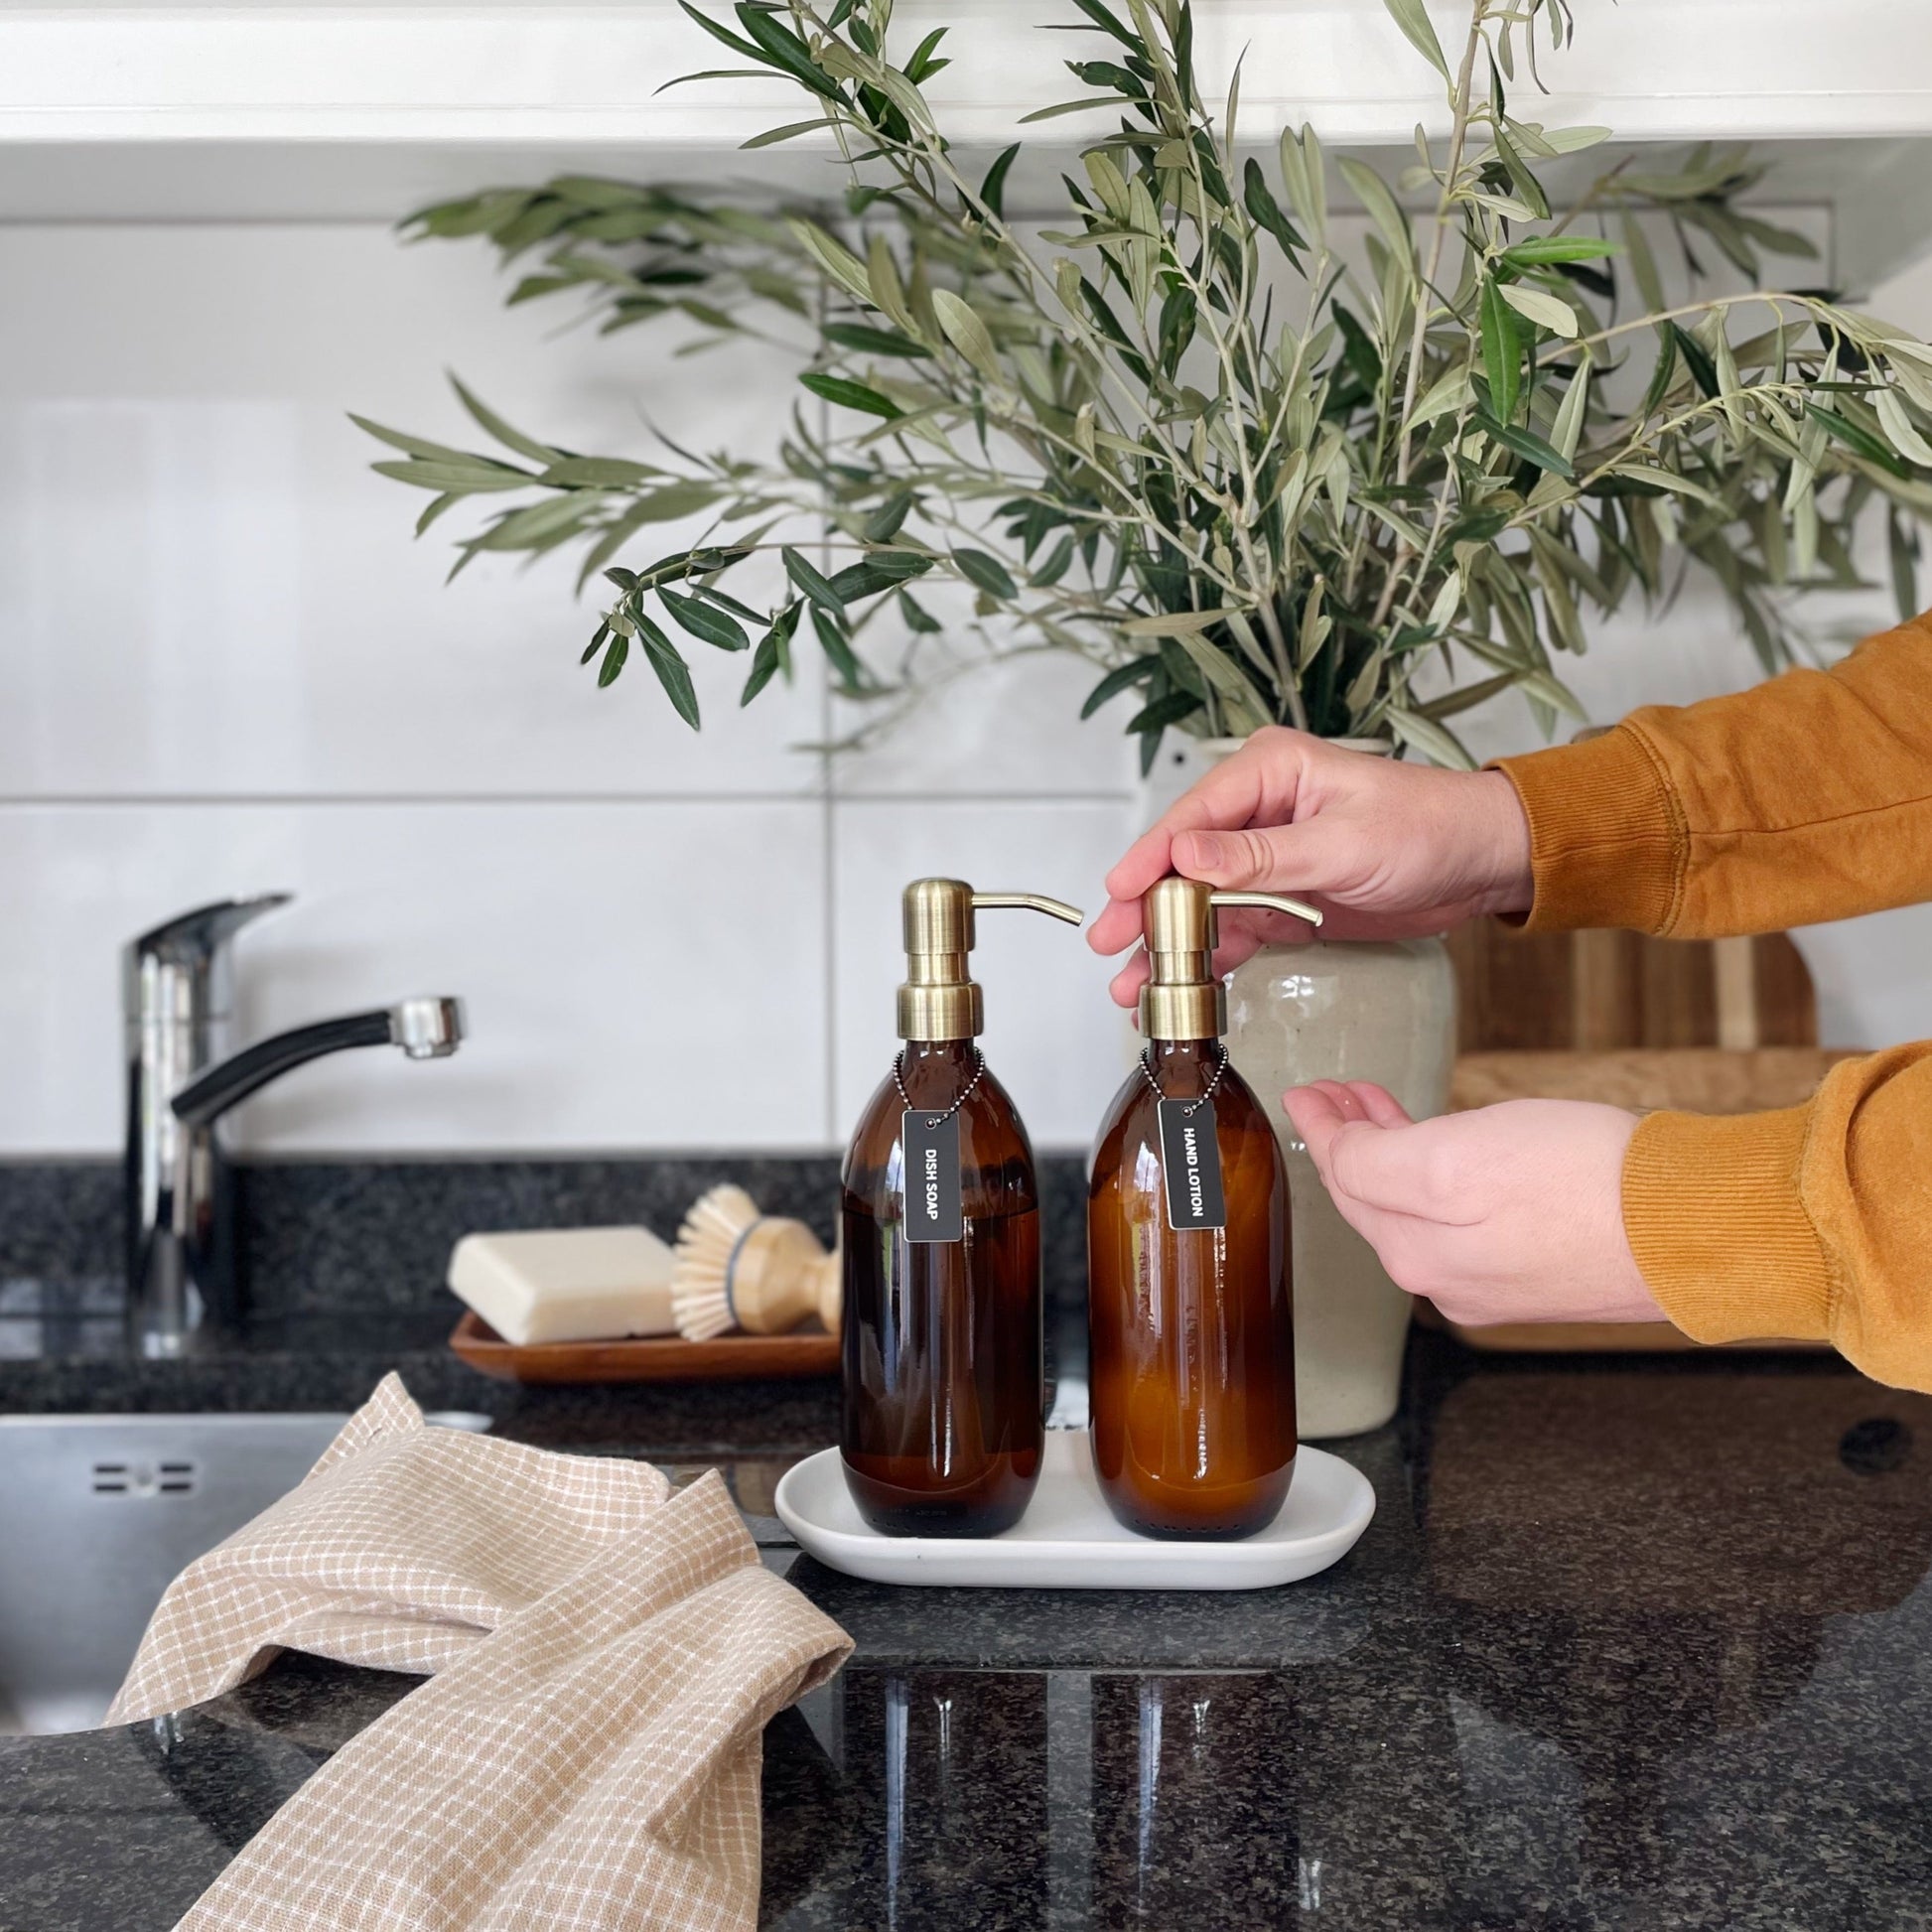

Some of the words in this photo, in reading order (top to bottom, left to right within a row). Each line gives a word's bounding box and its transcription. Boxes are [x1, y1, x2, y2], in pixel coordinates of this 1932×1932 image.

[925, 1149, 938, 1180] DISH
[1183, 1128, 1198, 1166] HAND
[925, 1183, 939, 1221] SOAP
[1188, 1169, 1204, 1217] LOTION
